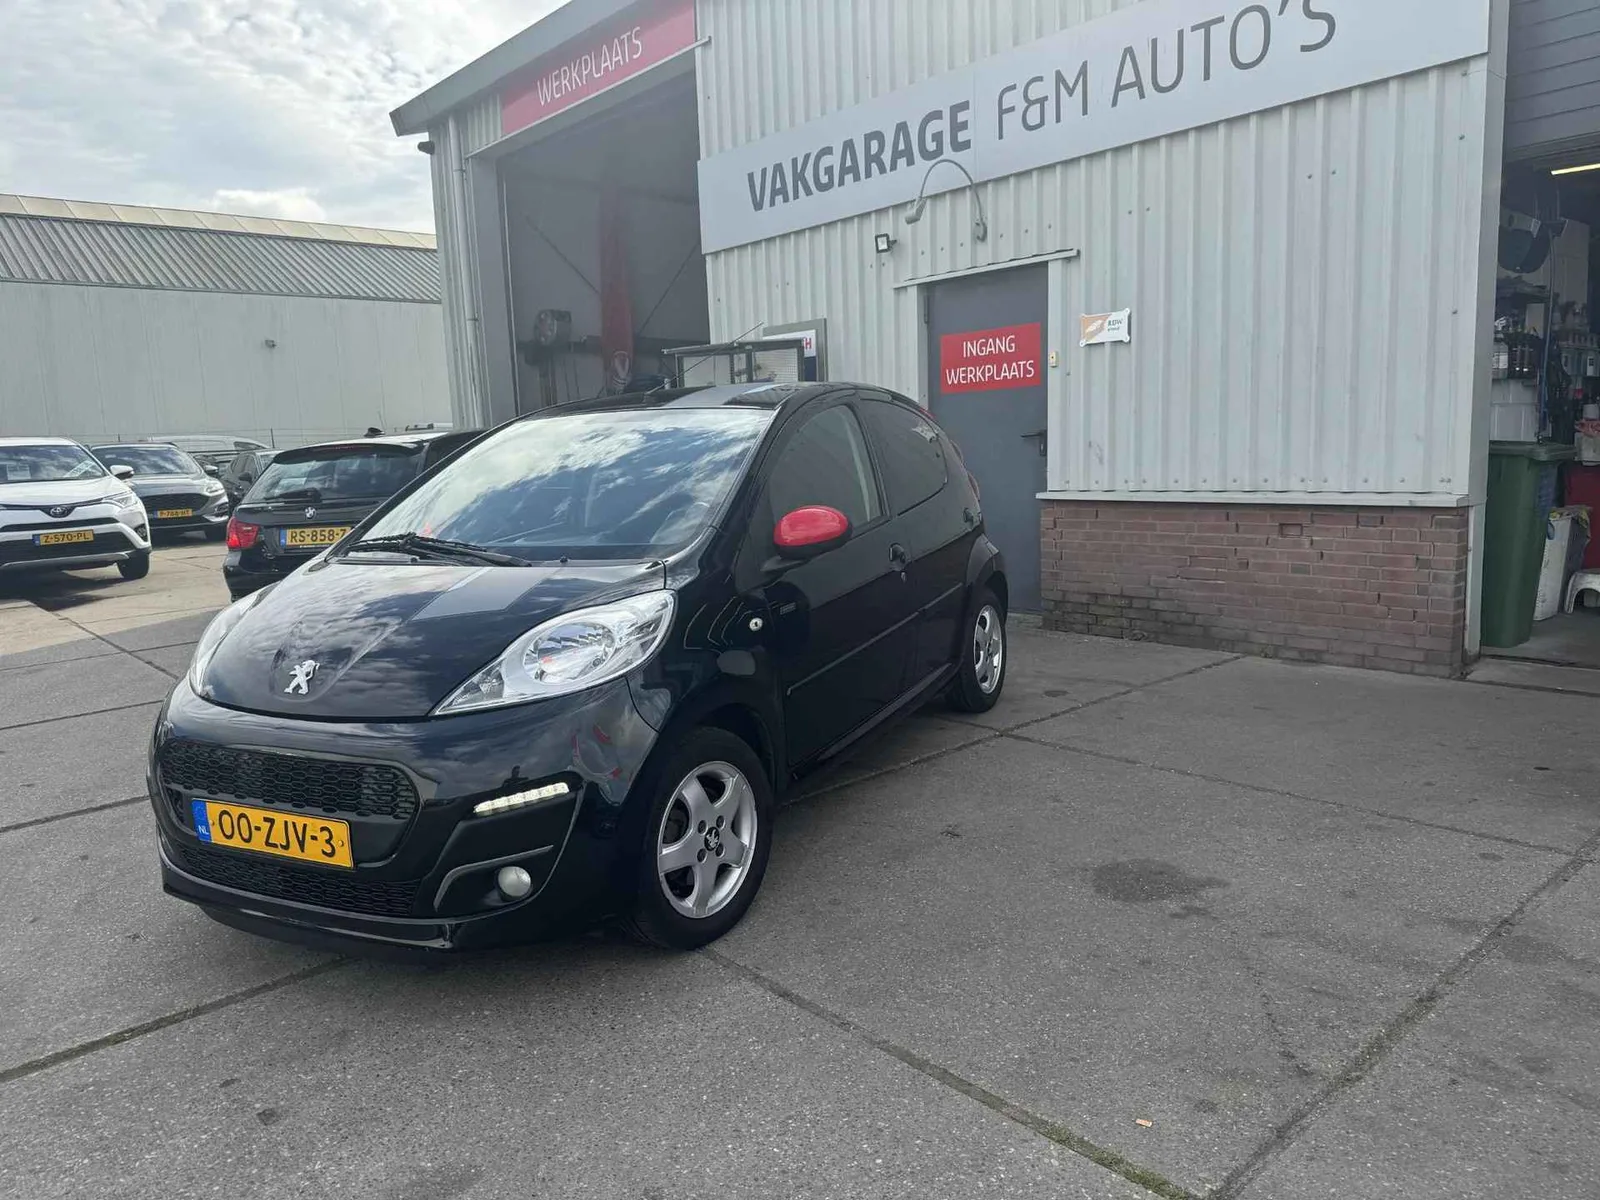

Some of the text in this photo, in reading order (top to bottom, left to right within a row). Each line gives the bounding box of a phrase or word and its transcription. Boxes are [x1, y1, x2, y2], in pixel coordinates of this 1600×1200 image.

[537, 26, 642, 107] WERKPLAATS
[747, 0, 1336, 212] VAKGARAGE F&M AUTO'S
[963, 335, 1016, 358] INGANG
[946, 360, 1035, 385] WERKPLAATS
[198, 809, 336, 858] NL 00-ZJV-3
